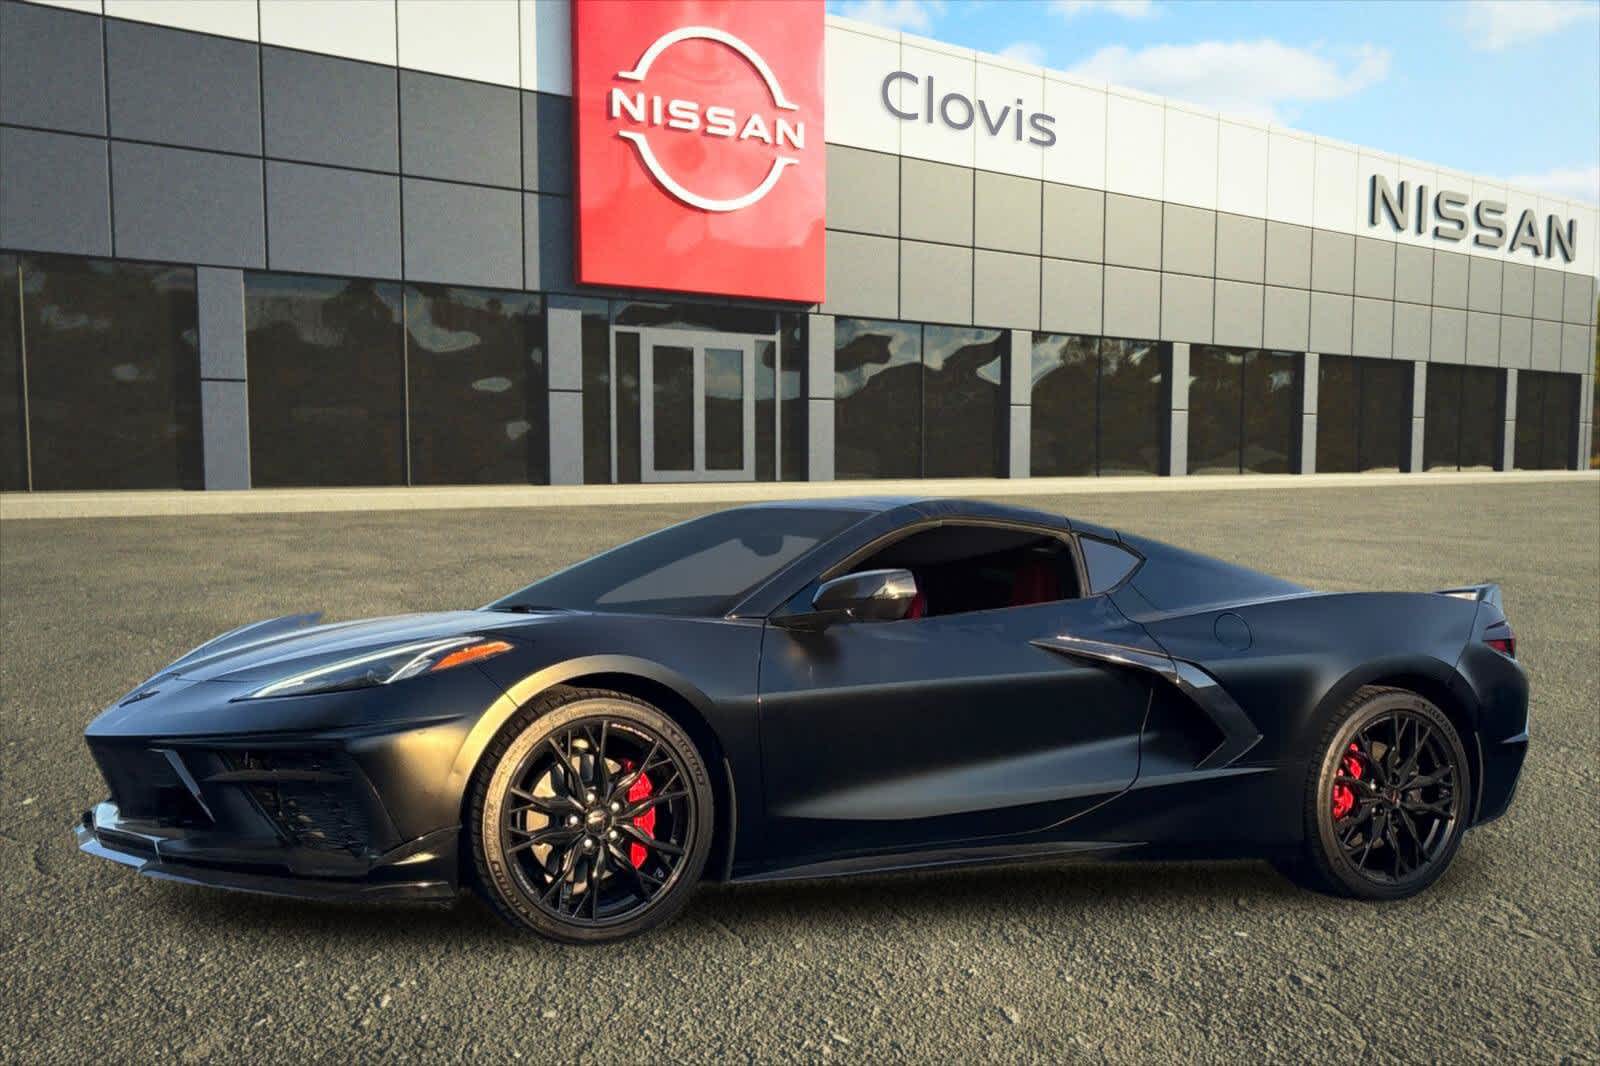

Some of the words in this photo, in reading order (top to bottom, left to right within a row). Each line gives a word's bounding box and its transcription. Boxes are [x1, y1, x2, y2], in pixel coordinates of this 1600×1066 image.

[611, 88, 805, 149] NISSAN
[881, 71, 1057, 147] Clovis
[1369, 174, 1577, 263] NISSAN
